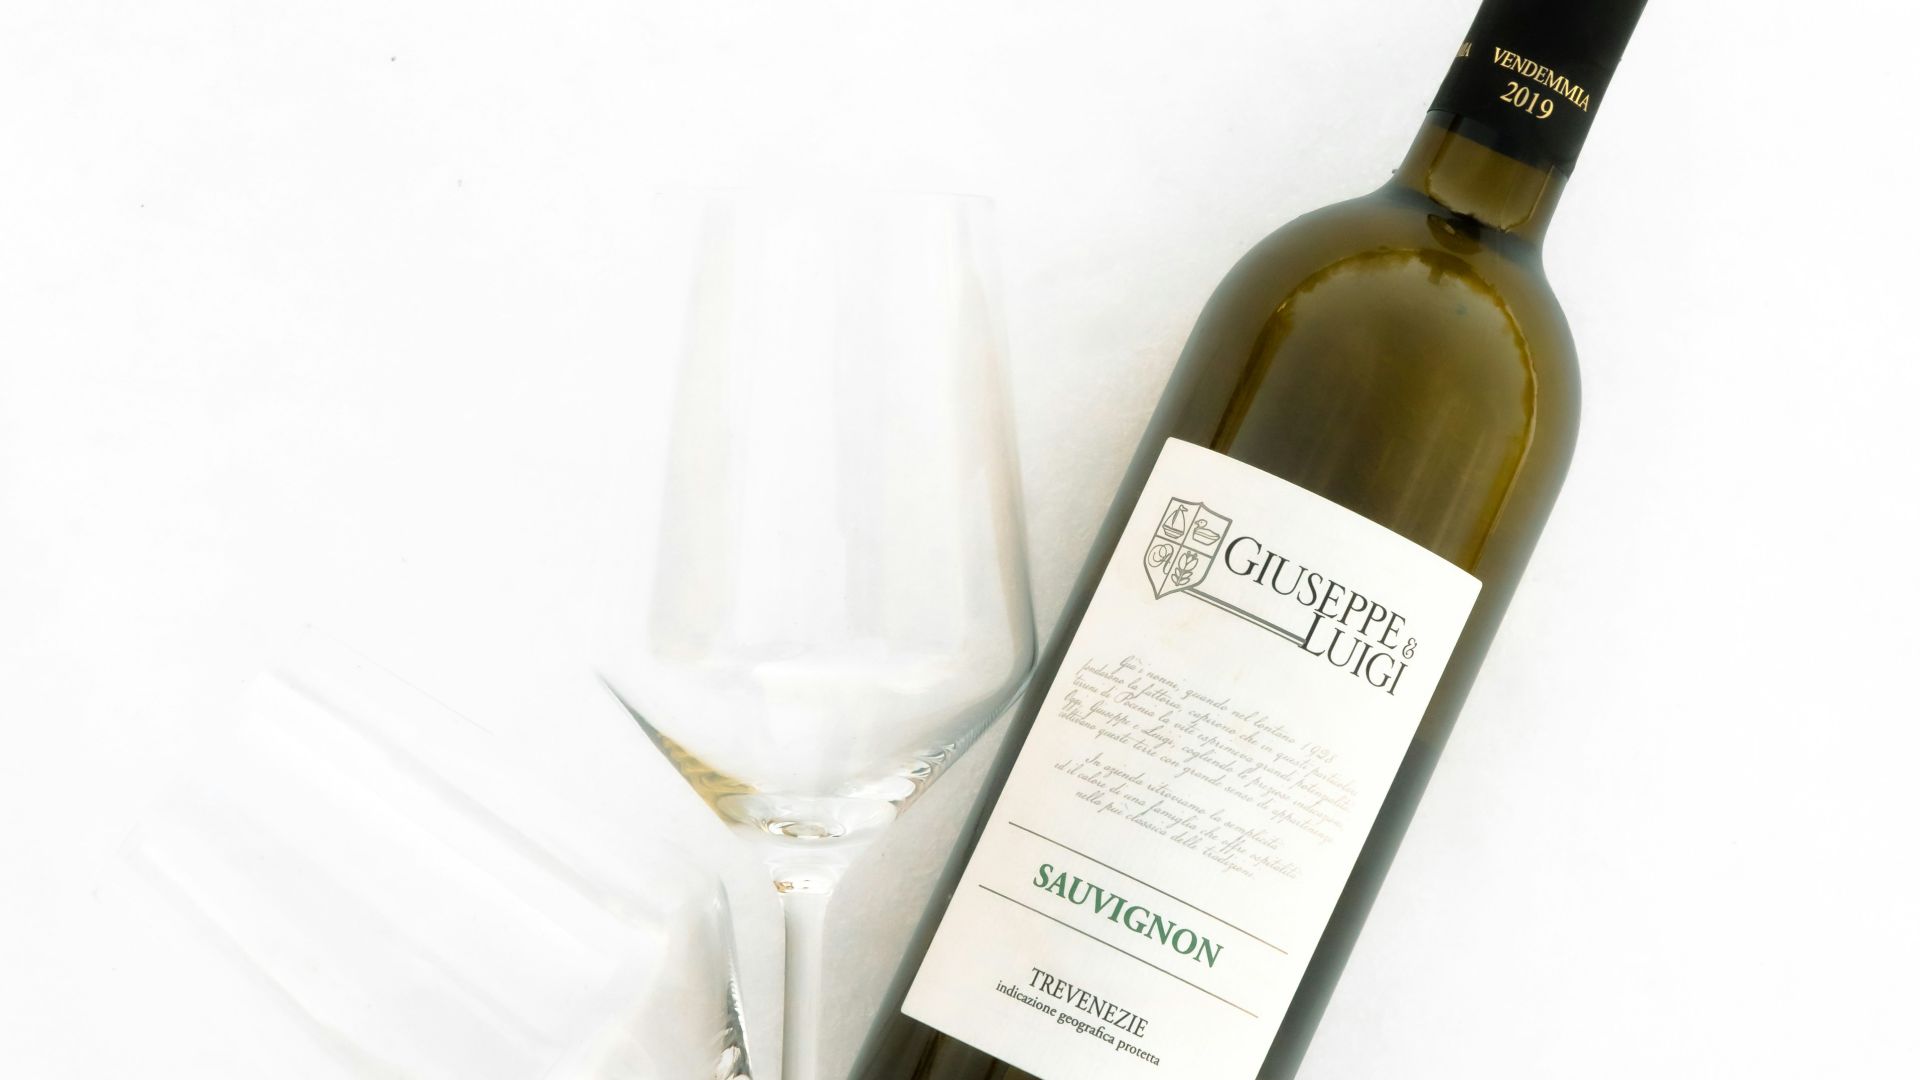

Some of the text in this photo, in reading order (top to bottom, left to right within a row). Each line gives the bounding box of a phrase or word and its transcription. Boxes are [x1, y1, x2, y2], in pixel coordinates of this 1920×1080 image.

[1493, 46, 1590, 113] VENDEMMIA
[1500, 81, 1555, 120] 2019
[1224, 535, 1406, 650] GIUSEPPE
[1402, 637, 1418, 659] &
[1299, 611, 1408, 696] LUIGI
[1081, 699, 1129, 727] Giuseppe
[1181, 745, 1236, 772] cogliendo
[1099, 684, 1116, 699] di
[1113, 691, 1157, 717] Pocenia
[1157, 710, 1173, 724] la
[1173, 722, 1200, 736] vite
[1126, 677, 1142, 691] la
[1187, 712, 1236, 735] capirono
[1238, 731, 1260, 746] che
[1180, 688, 1231, 711] quando
[1231, 709, 1259, 723] nel
[1252, 716, 1296, 744] lontano
[1102, 764, 1145, 786] azienda
[1145, 782, 1205, 815] ritroviamo
[1208, 808, 1225, 822] la
[1158, 755, 1179, 768] con
[1173, 766, 1226, 787] grande
[1074, 789, 1105, 807] nella
[1168, 831, 1203, 851] delle
[1076, 771, 1106, 789] calore
[1108, 782, 1127, 796] di
[1122, 792, 1146, 807] una
[1139, 799, 1197, 830] famiglia
[1199, 826, 1221, 841] che
[1033, 863, 1224, 968] SAUVIGNON
[995, 980, 1160, 1066] indicazione geografica protetta
[1028, 968, 1149, 1039] TREVENEZIE
